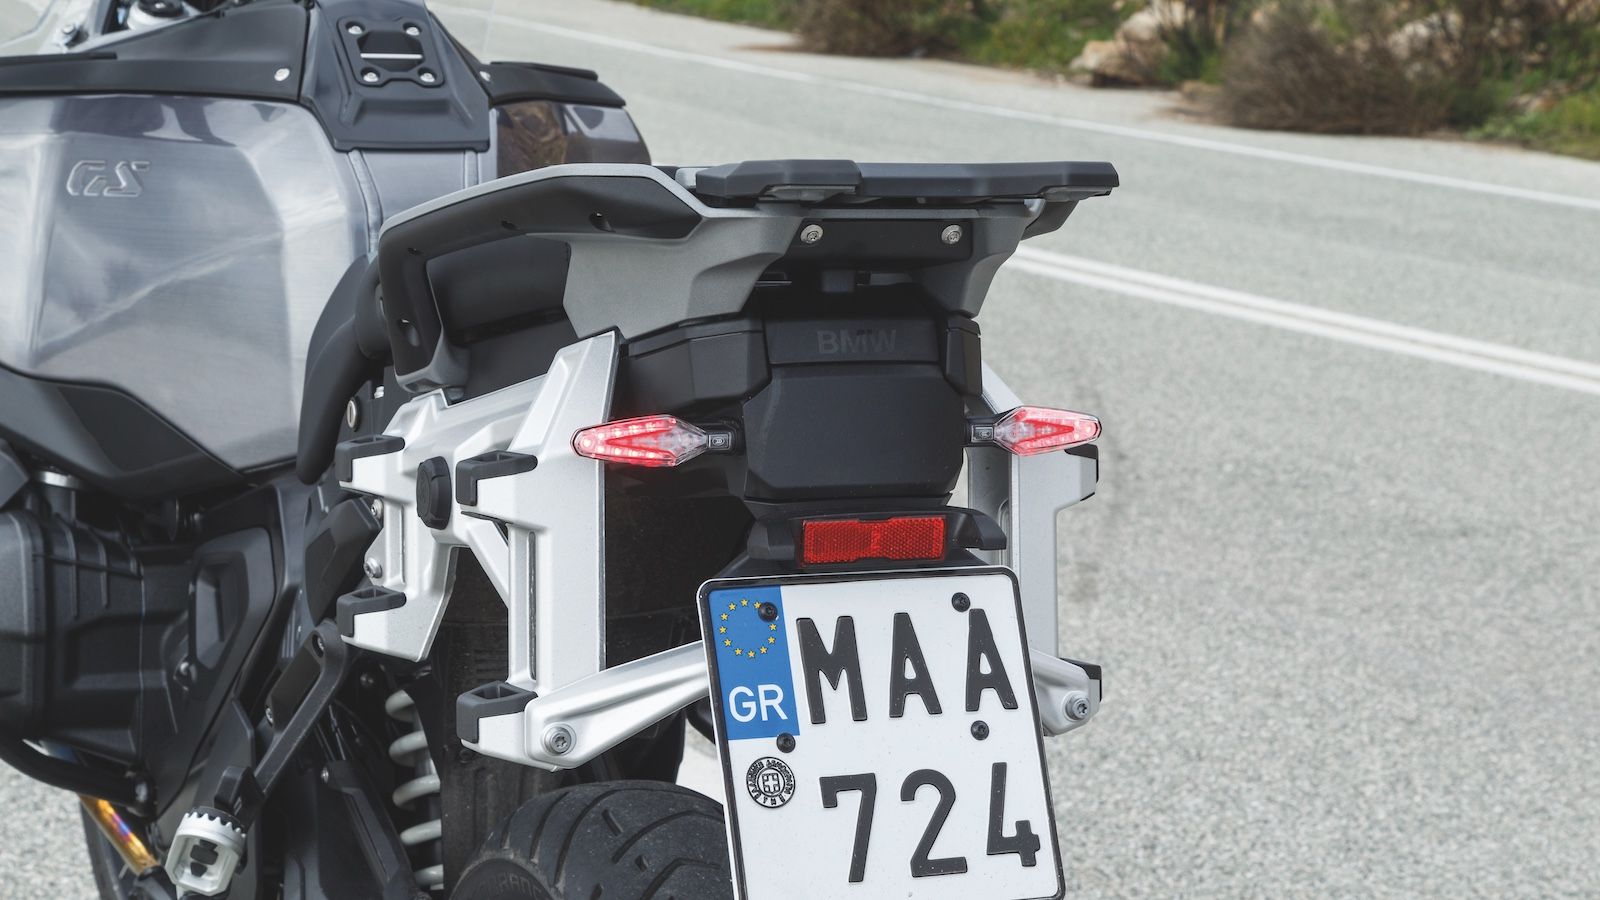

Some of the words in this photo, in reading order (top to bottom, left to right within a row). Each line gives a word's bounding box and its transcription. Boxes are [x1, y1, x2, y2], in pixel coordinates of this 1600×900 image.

[66, 160, 151, 197] GS
[817, 329, 897, 354] BMW
[796, 608, 1018, 724] MAA
[728, 684, 788, 723] GR
[819, 762, 1041, 883] 724
